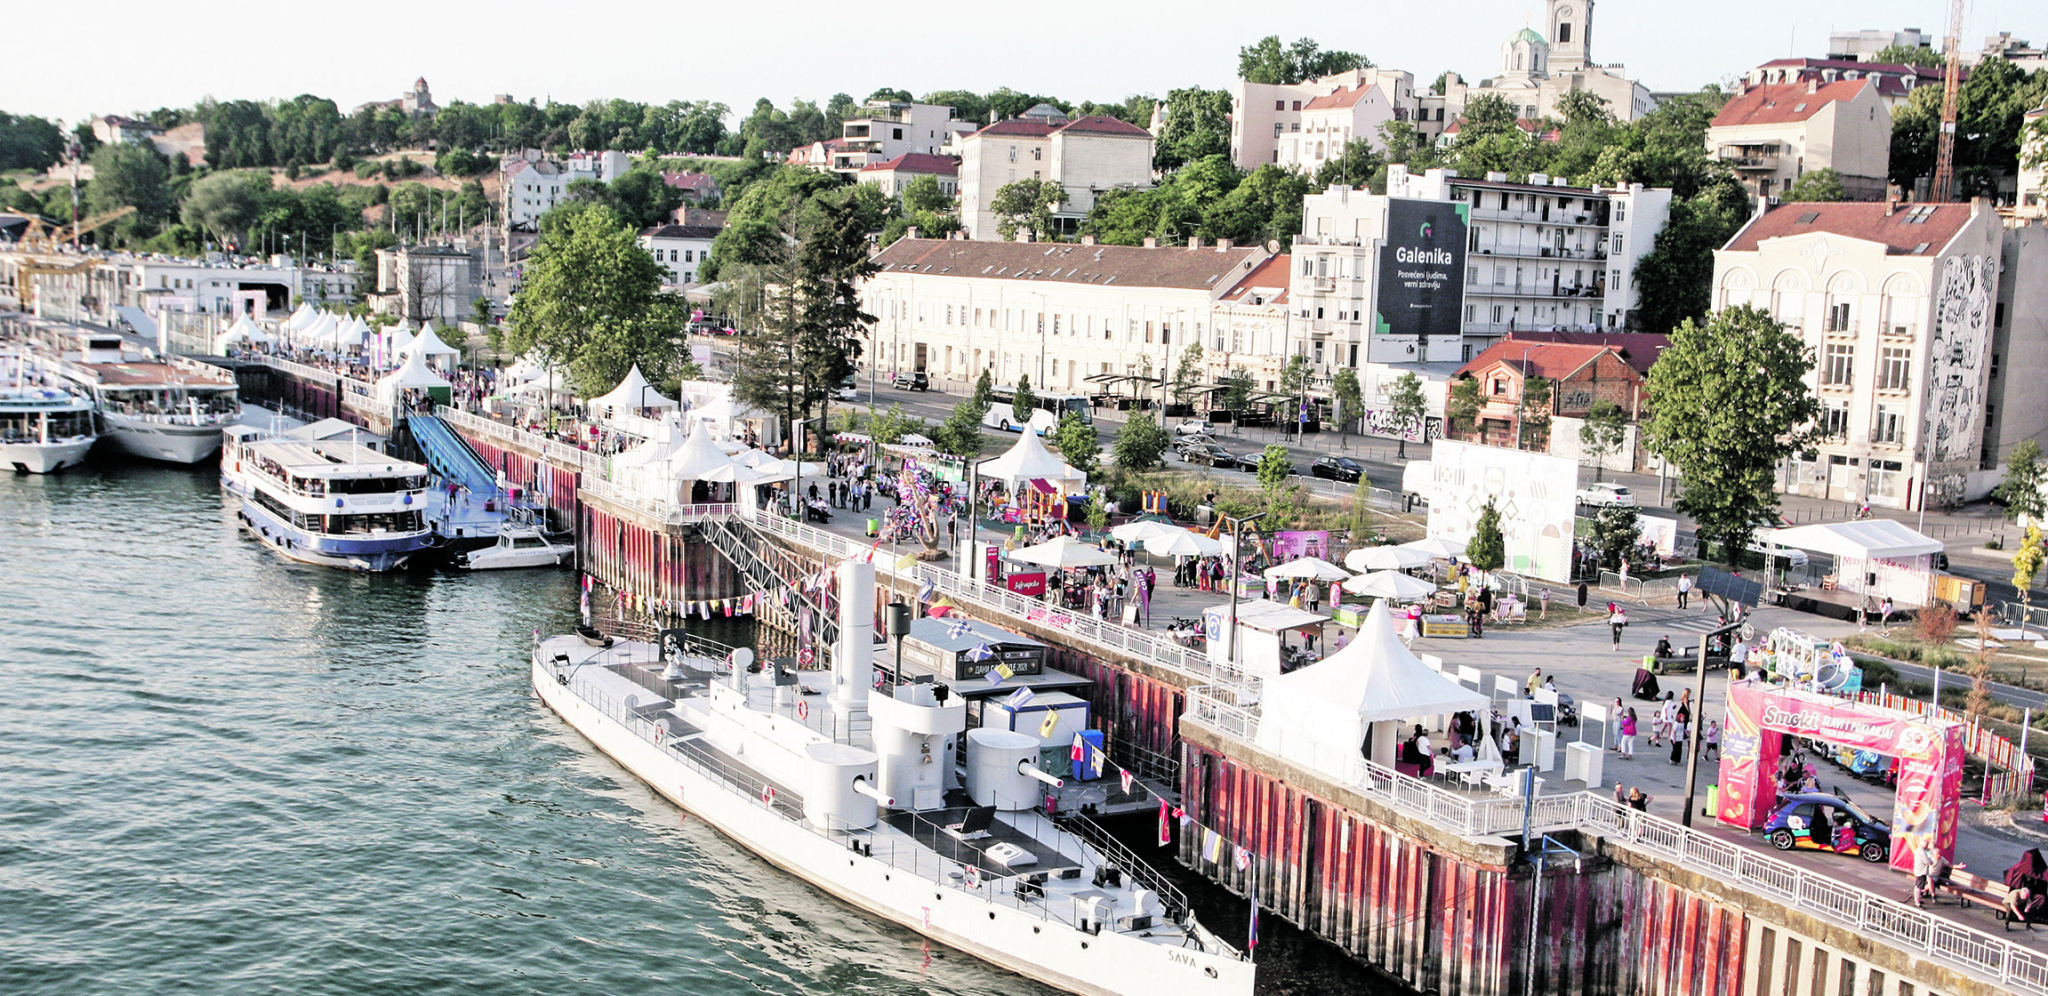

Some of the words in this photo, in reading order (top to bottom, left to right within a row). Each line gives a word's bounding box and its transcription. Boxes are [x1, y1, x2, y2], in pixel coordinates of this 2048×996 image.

[1396, 246, 1452, 265] Galenika
[1398, 270, 1425, 279] Posvećeni
[1419, 281, 1440, 290] zdravlju
[975, 664, 990, 675] ДАНИ
[1016, 662, 1028, 672] 2021
[1763, 705, 1819, 730] Smoki
[1821, 715, 1845, 730] SLAVI
[1850, 720, 1895, 740] POKLANJA!
[1168, 949, 1197, 969] SAVA
